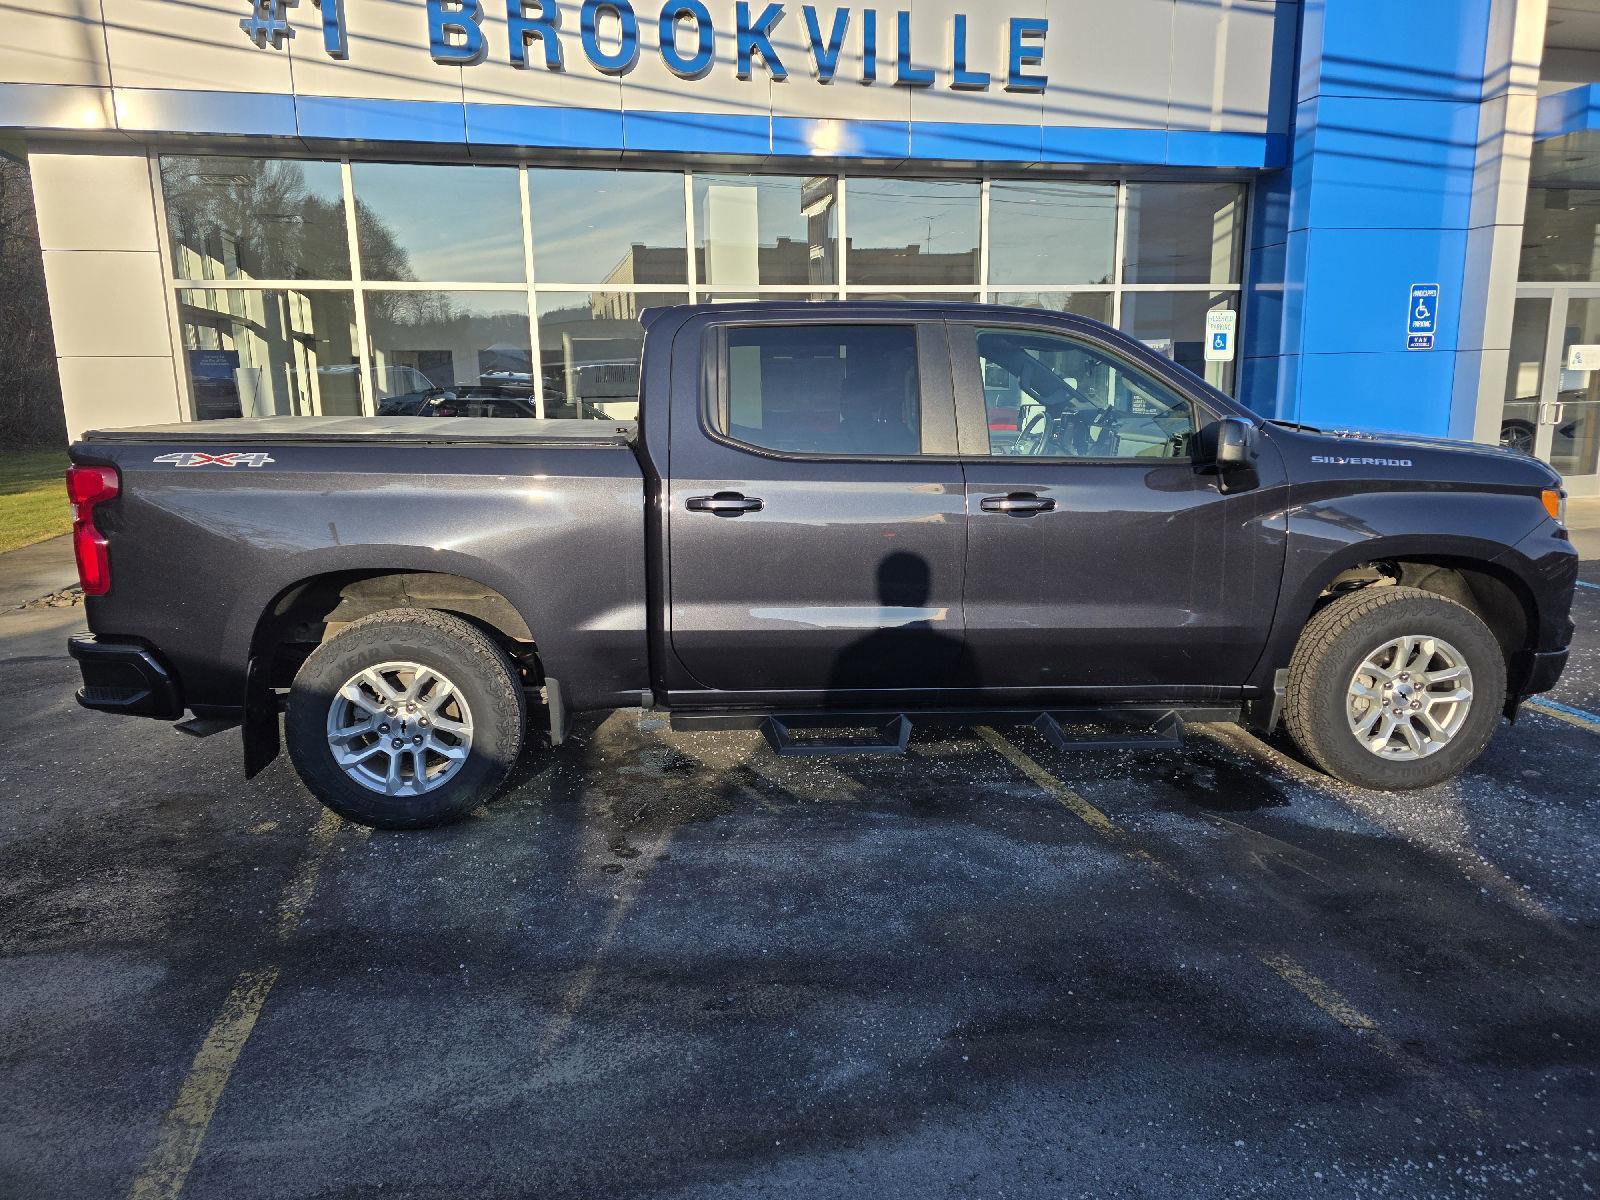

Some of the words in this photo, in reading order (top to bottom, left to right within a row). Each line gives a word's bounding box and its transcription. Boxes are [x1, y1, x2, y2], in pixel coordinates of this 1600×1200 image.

[426, 0, 1049, 90] BROOKVILLE
[1412, 320, 1432, 328] PARKING
[1311, 455, 1413, 467] SILVERADO
